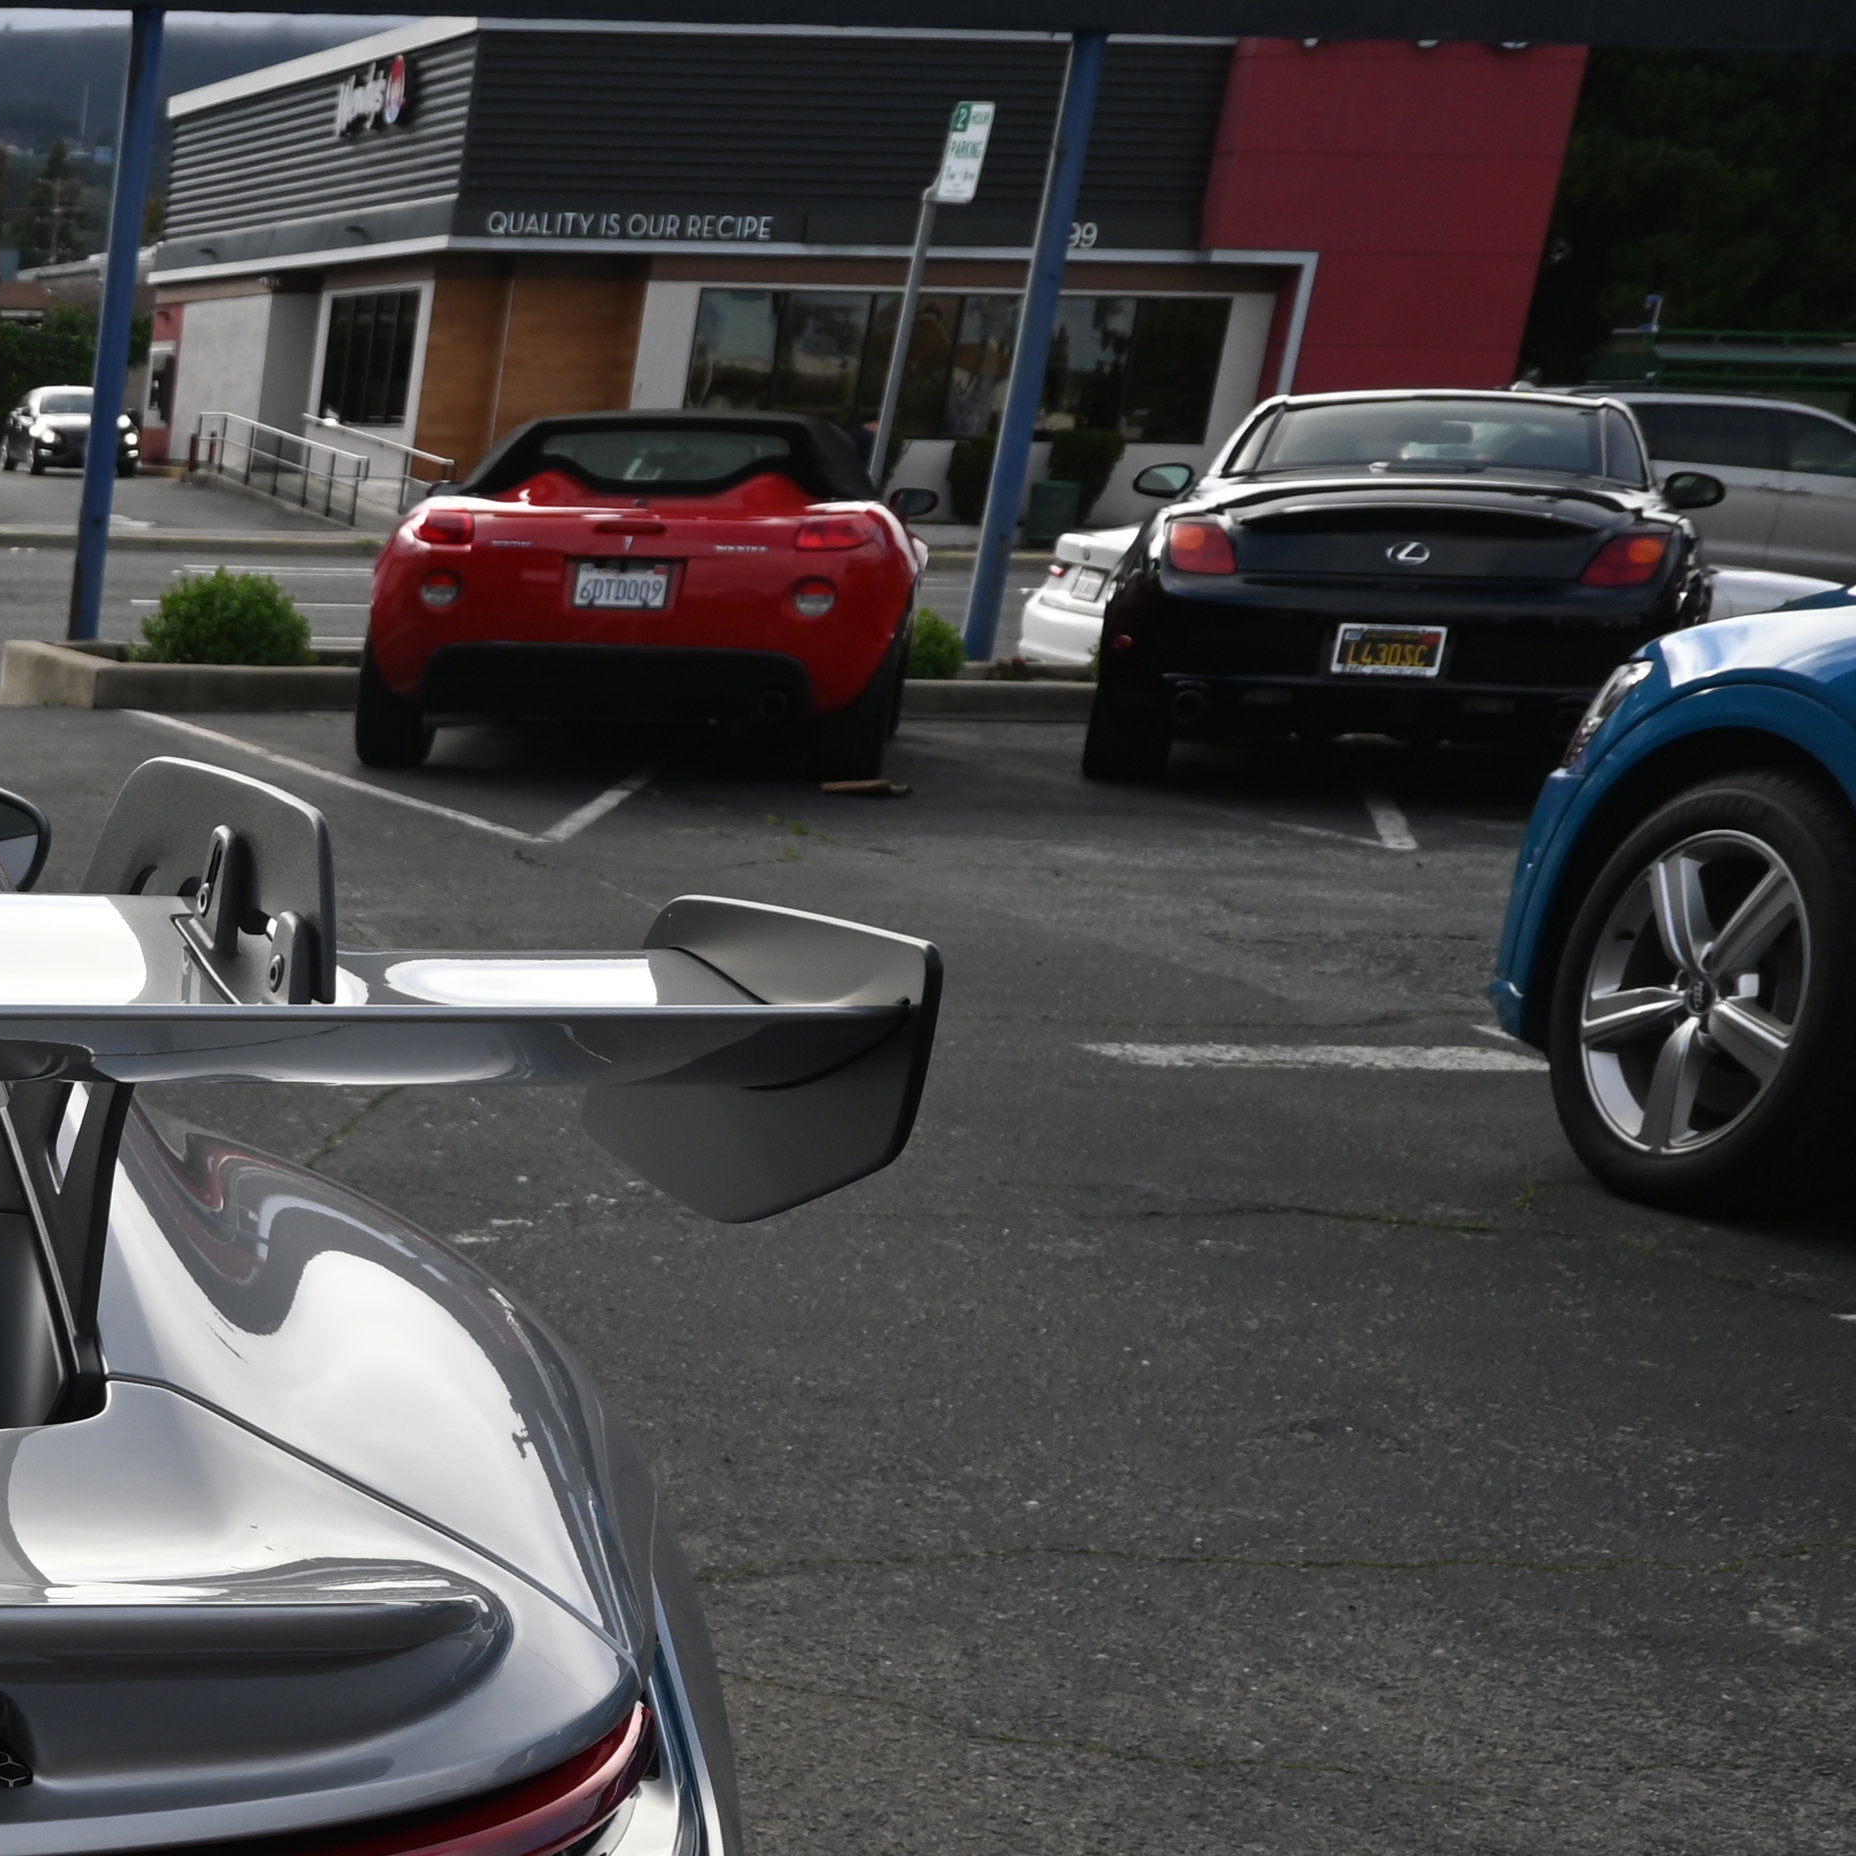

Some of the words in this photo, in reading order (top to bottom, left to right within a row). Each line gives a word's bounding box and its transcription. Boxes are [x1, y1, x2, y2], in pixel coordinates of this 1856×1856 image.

[957, 107, 968, 130] 2
[487, 211, 594, 237] QUALITY
[600, 213, 621, 237] IS
[626, 213, 681, 238] OUR
[686, 215, 774, 240] RECIPE
